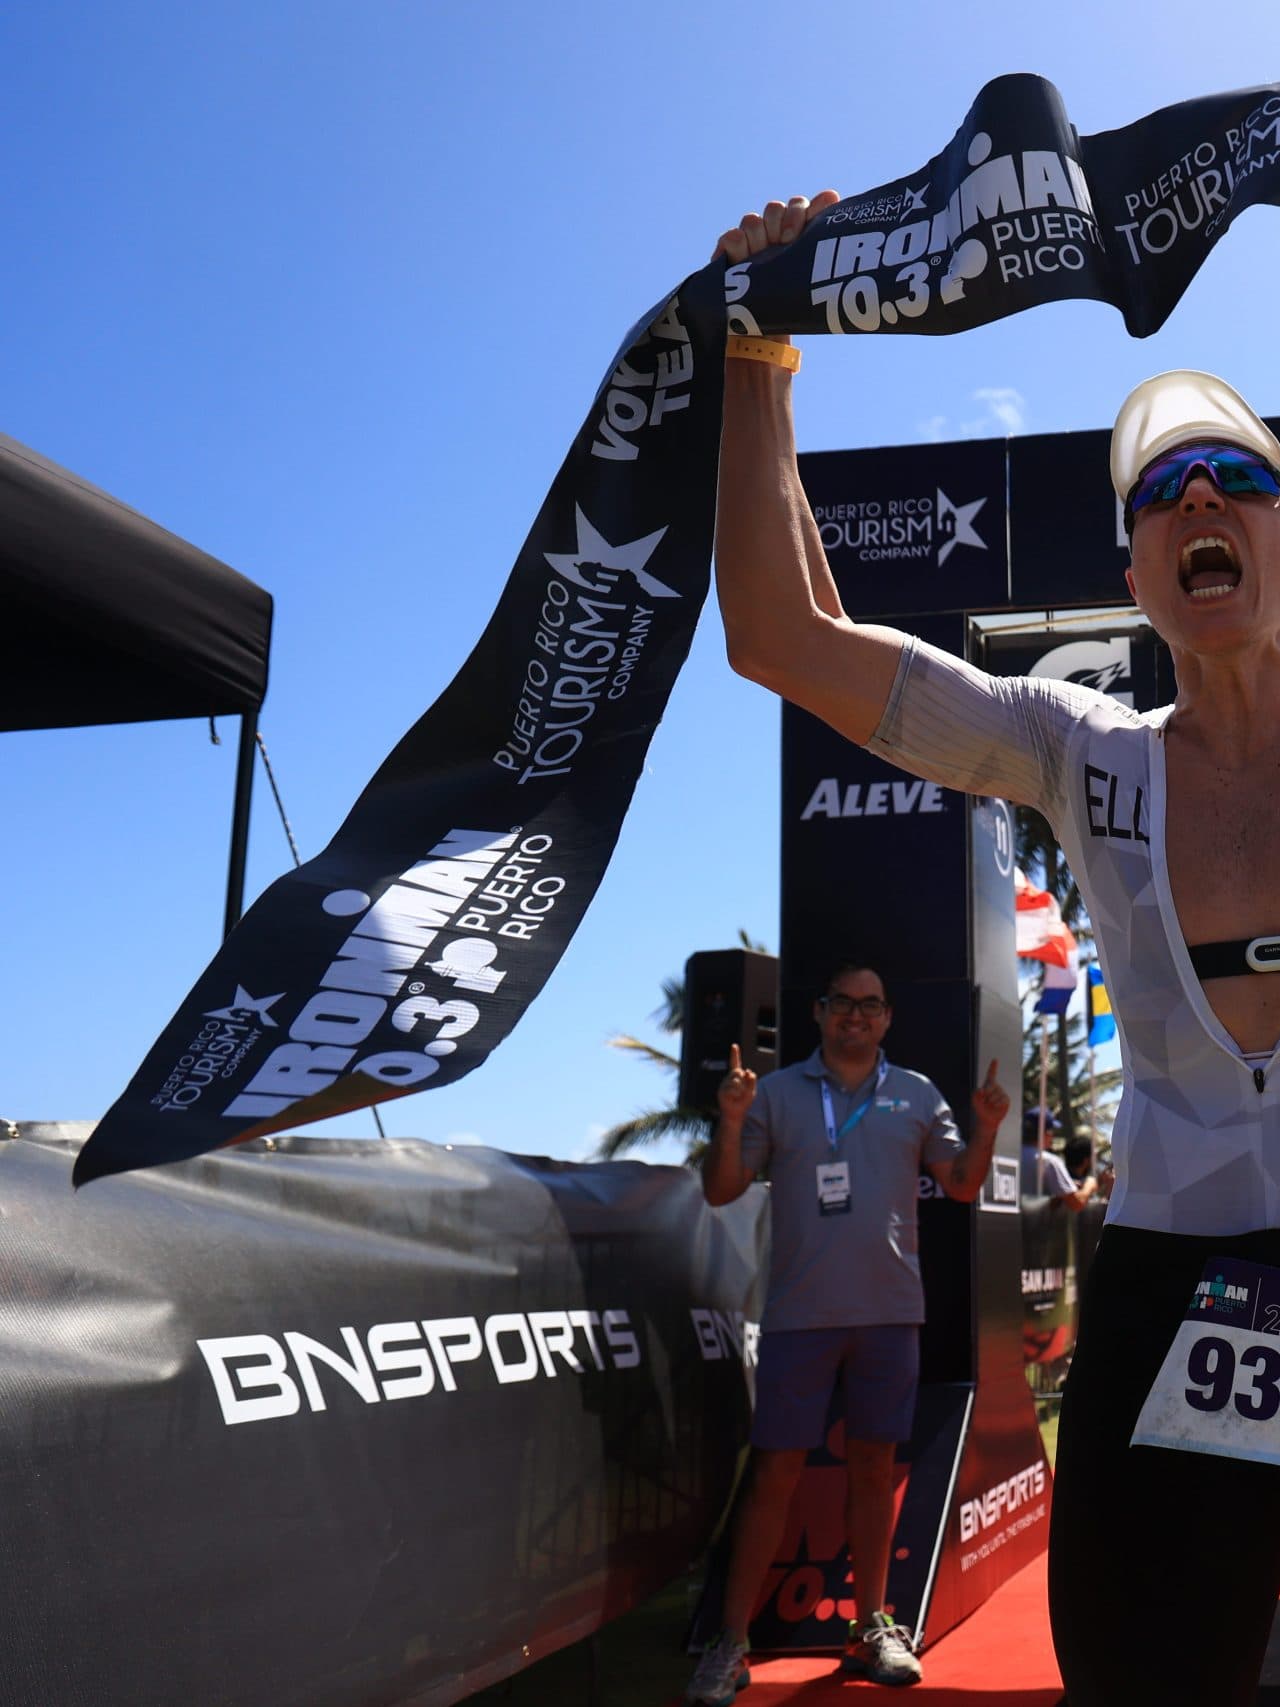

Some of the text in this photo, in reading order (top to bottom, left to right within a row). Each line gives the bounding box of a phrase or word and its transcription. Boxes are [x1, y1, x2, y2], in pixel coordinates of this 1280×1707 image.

[825, 202, 902, 225] TOURISM
[1125, 142, 1217, 217] PUERTO
[999, 244, 1085, 283] RICO
[814, 498, 933, 521] PUERTO RICO
[818, 517, 932, 551] OURISM
[859, 545, 930, 562] COMPANY
[492, 580, 571, 770] PUERTO RICO
[517, 595, 627, 785] TOURISM
[607, 605, 655, 701] COMPANY
[800, 778, 945, 821] ALEVE
[455, 834, 554, 932] PUERTO
[498, 876, 566, 940] RICO
[151, 1020, 221, 1105] PUERTO RICO
[160, 1024, 250, 1112] TOURISM
[221, 1028, 263, 1079] COMPANY
[354, 994, 481, 1087] 0.3
[196, 1308, 642, 1425] BNSPORTS
[960, 1459, 1046, 1544] BNSPORTS
